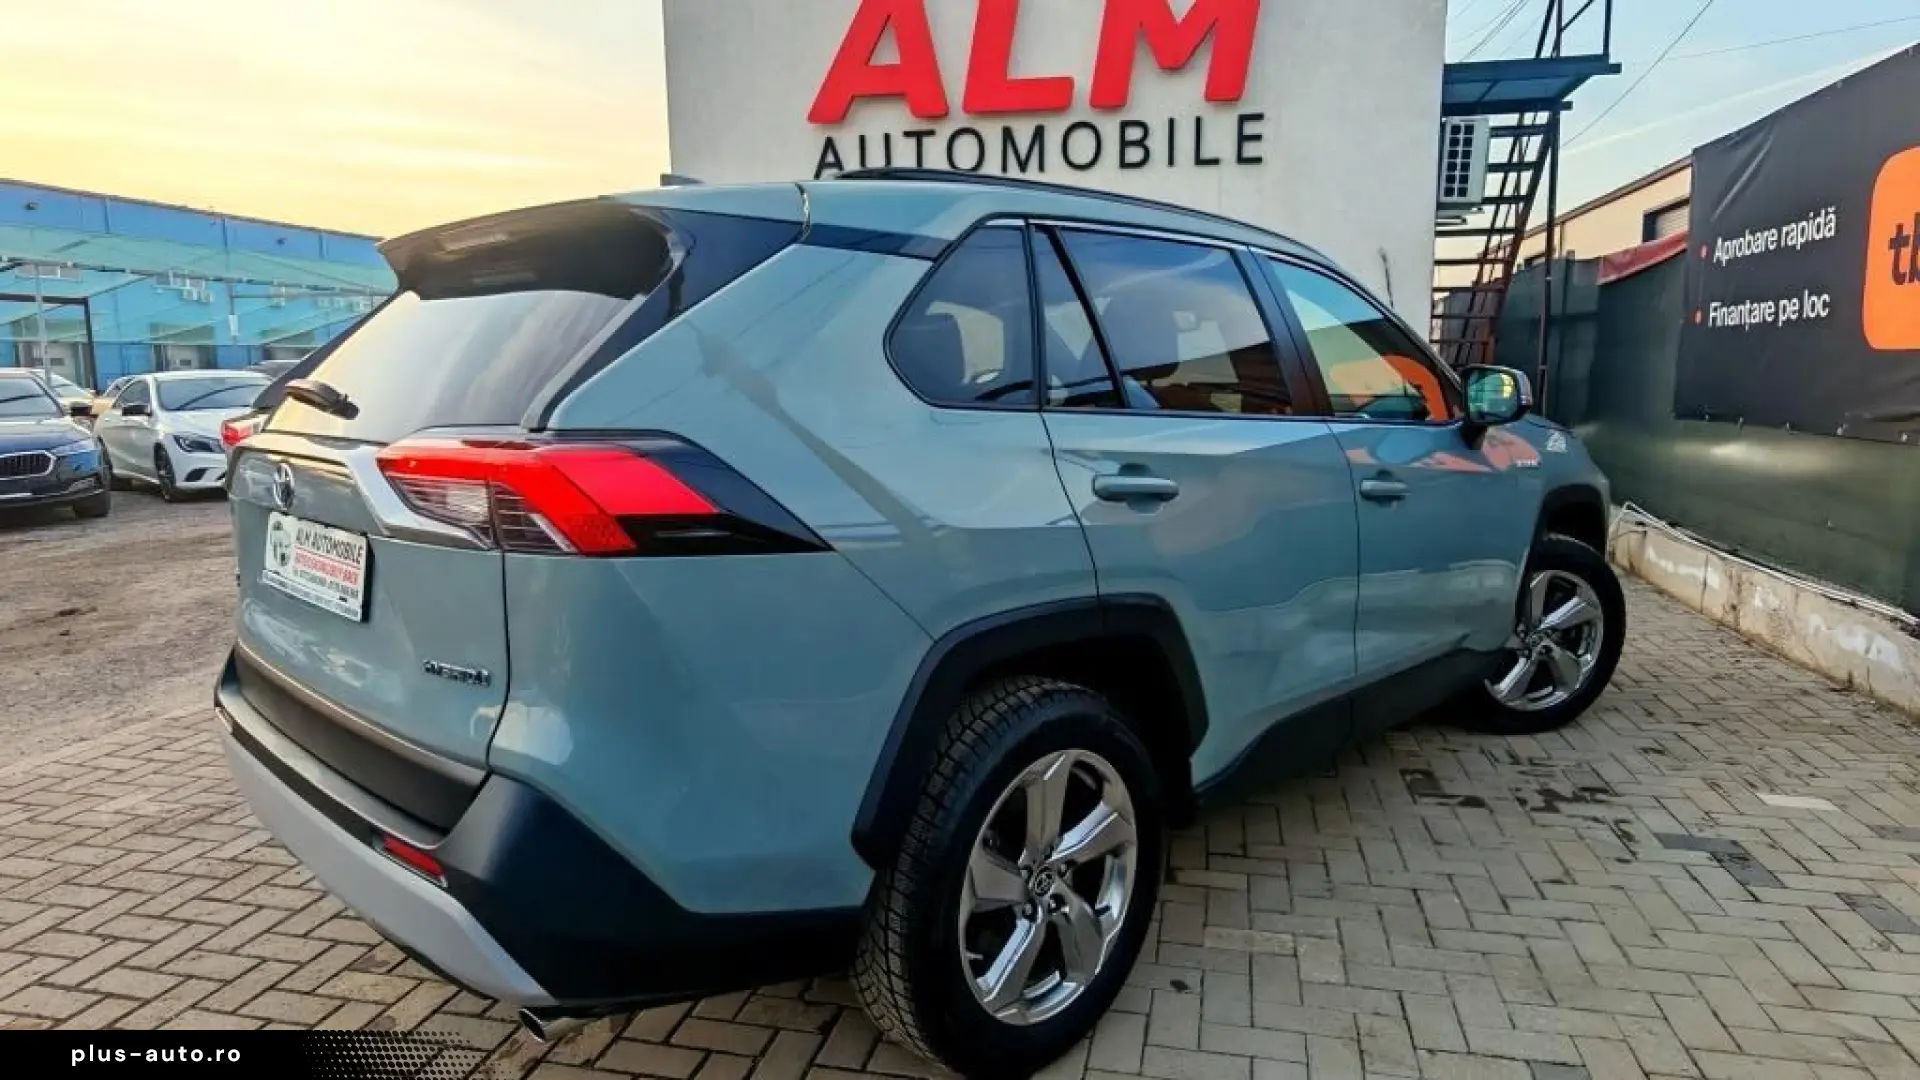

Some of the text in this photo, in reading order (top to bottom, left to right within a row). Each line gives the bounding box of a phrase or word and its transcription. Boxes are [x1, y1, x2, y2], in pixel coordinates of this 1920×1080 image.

[807, 0, 1260, 124] ALM
[813, 112, 1265, 180] AUTOMOBILE
[1713, 206, 1837, 267] Aprobare rapidă
[1708, 288, 1830, 332] Finanțare pe loc
[311, 531, 364, 565] AUTOMOBILE
